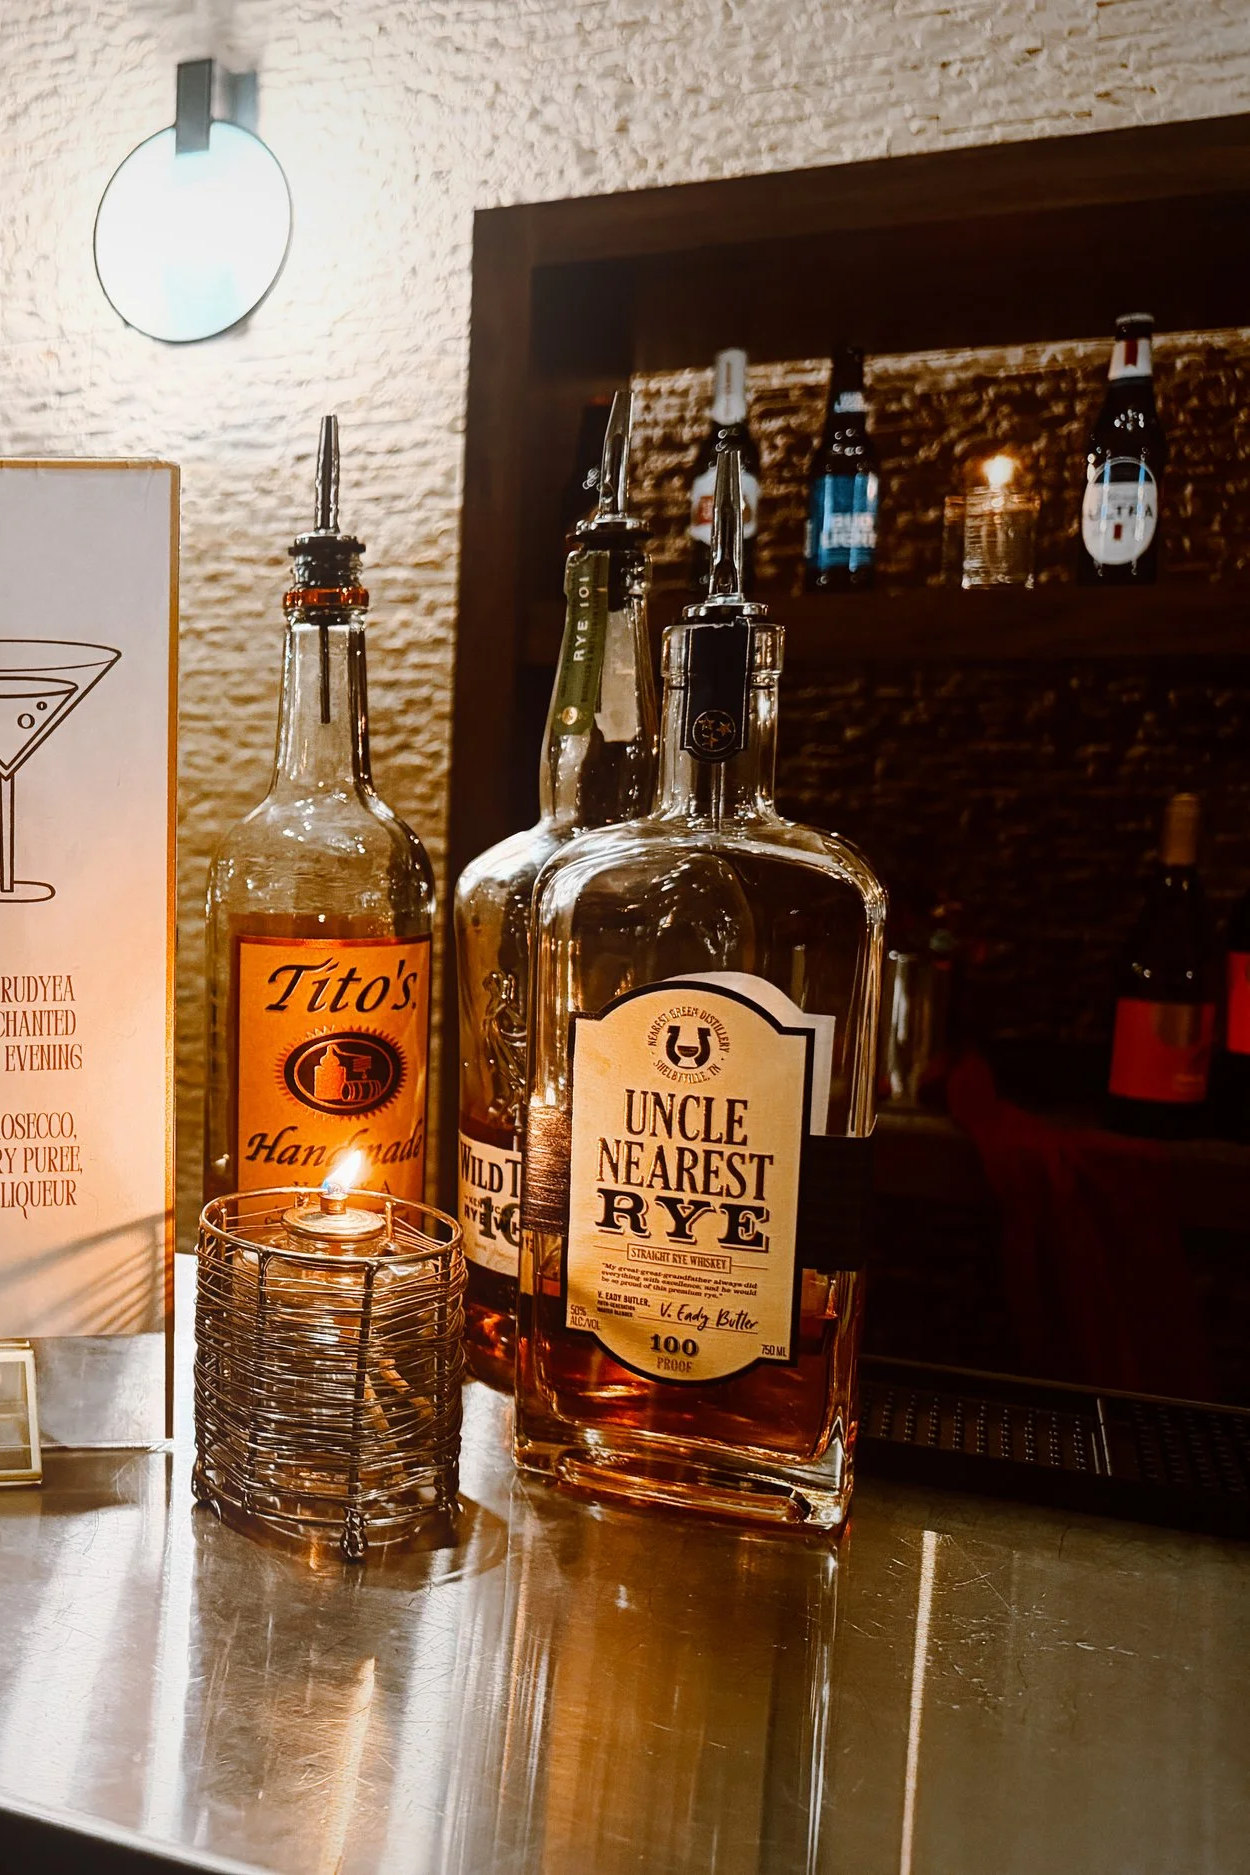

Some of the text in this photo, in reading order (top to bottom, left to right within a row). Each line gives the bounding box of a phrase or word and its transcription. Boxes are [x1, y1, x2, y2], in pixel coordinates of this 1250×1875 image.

[573, 576, 590, 662] RYE 101
[1, 975, 75, 1003] RUDYEA
[265, 957, 418, 1013] Tito's
[648, 1006, 730, 1053] NEAREST GREEN DISTILLERY
[5, 1043, 83, 1071] EVENING
[707, 1063, 722, 1076] TN
[624, 1088, 748, 1146] UNCLE
[23, 1146, 83, 1174] PUREE,
[460, 1141, 503, 1193] WILD
[596, 1136, 774, 1200] NEAREST
[1, 1180, 77, 1219] LIQUEUR
[595, 1187, 770, 1253] RYE
[631, 1248, 727, 1270] STRAIGHT RYE WHISKEY
[570, 1304, 587, 1316] 50%
[605, 1292, 622, 1301] EADY
[660, 1302, 758, 1331] V. Eady Butler
[650, 1333, 699, 1357] 100
[761, 1344, 787, 1357] 750 ML
[657, 1357, 693, 1372] PROOF
